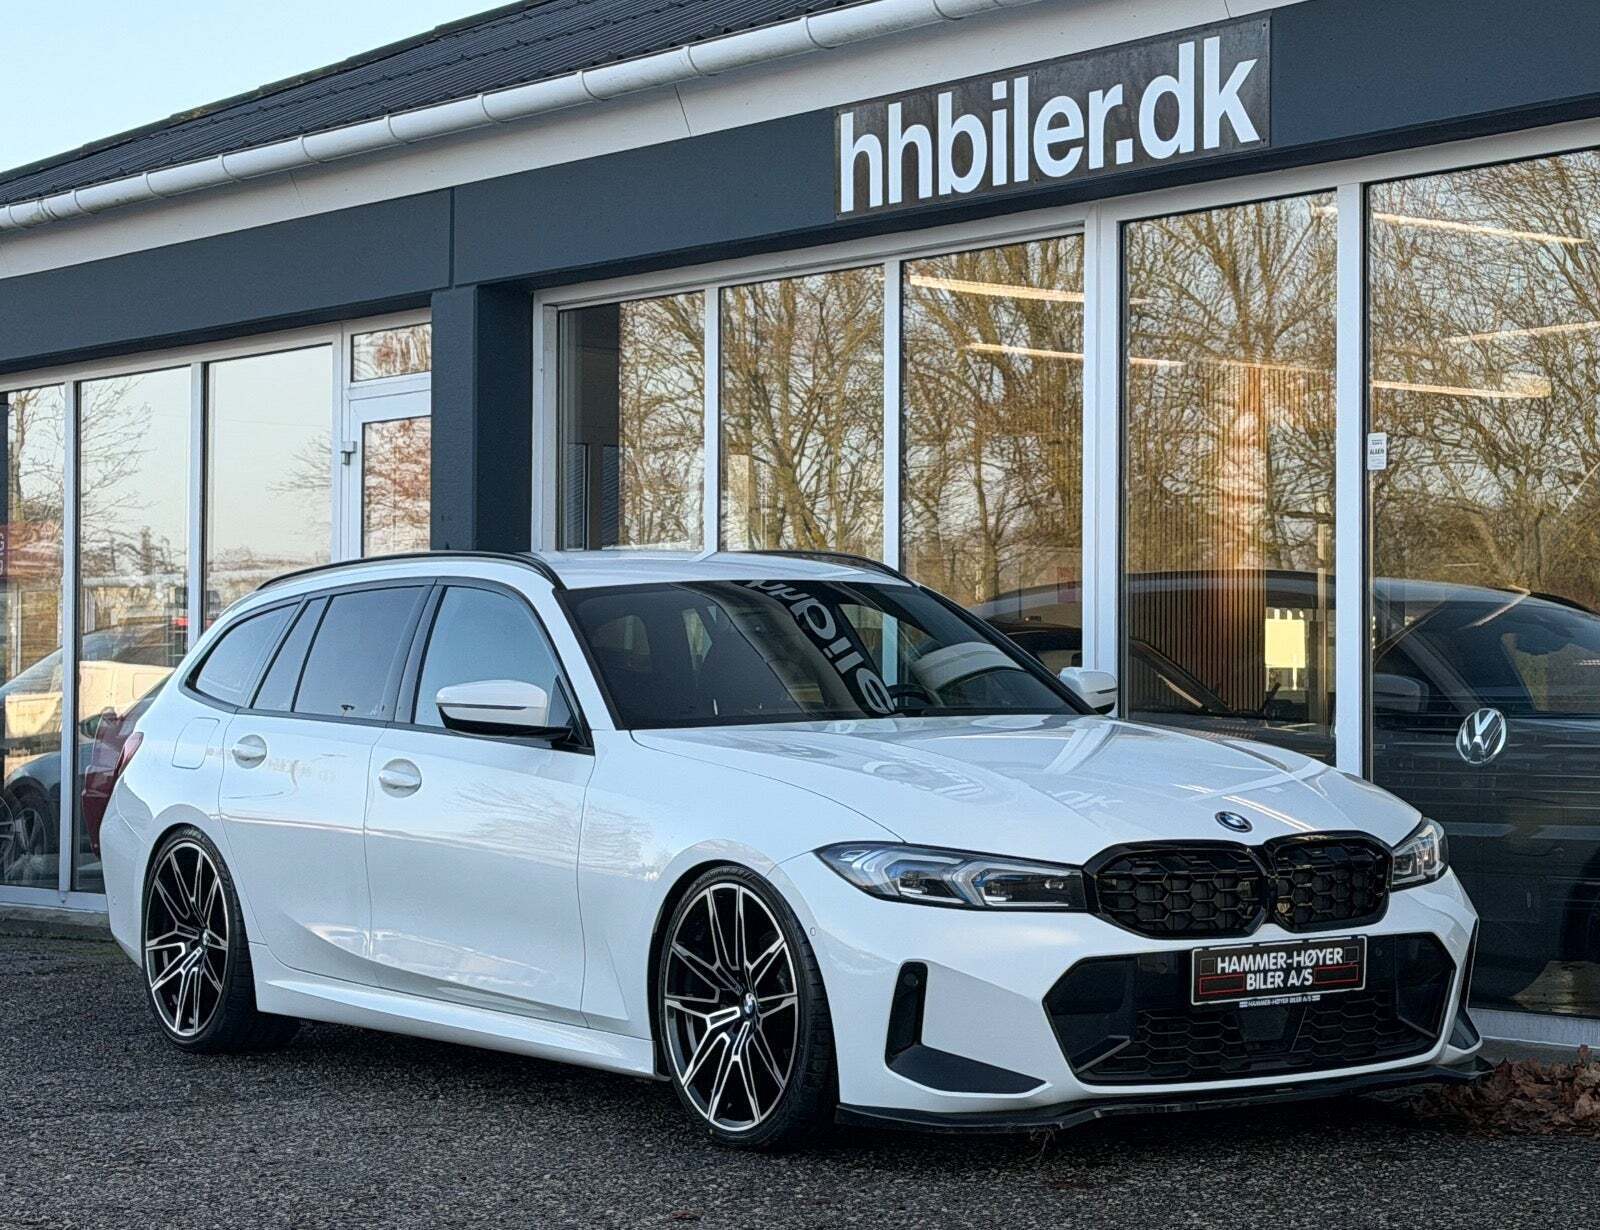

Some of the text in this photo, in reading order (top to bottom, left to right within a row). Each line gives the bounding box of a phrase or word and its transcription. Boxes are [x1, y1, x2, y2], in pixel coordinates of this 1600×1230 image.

[840, 36, 1260, 213] hhbiler.dk
[1217, 948, 1343, 974] HAMMER-HØYER
[1246, 968, 1313, 991] BILER A/S
